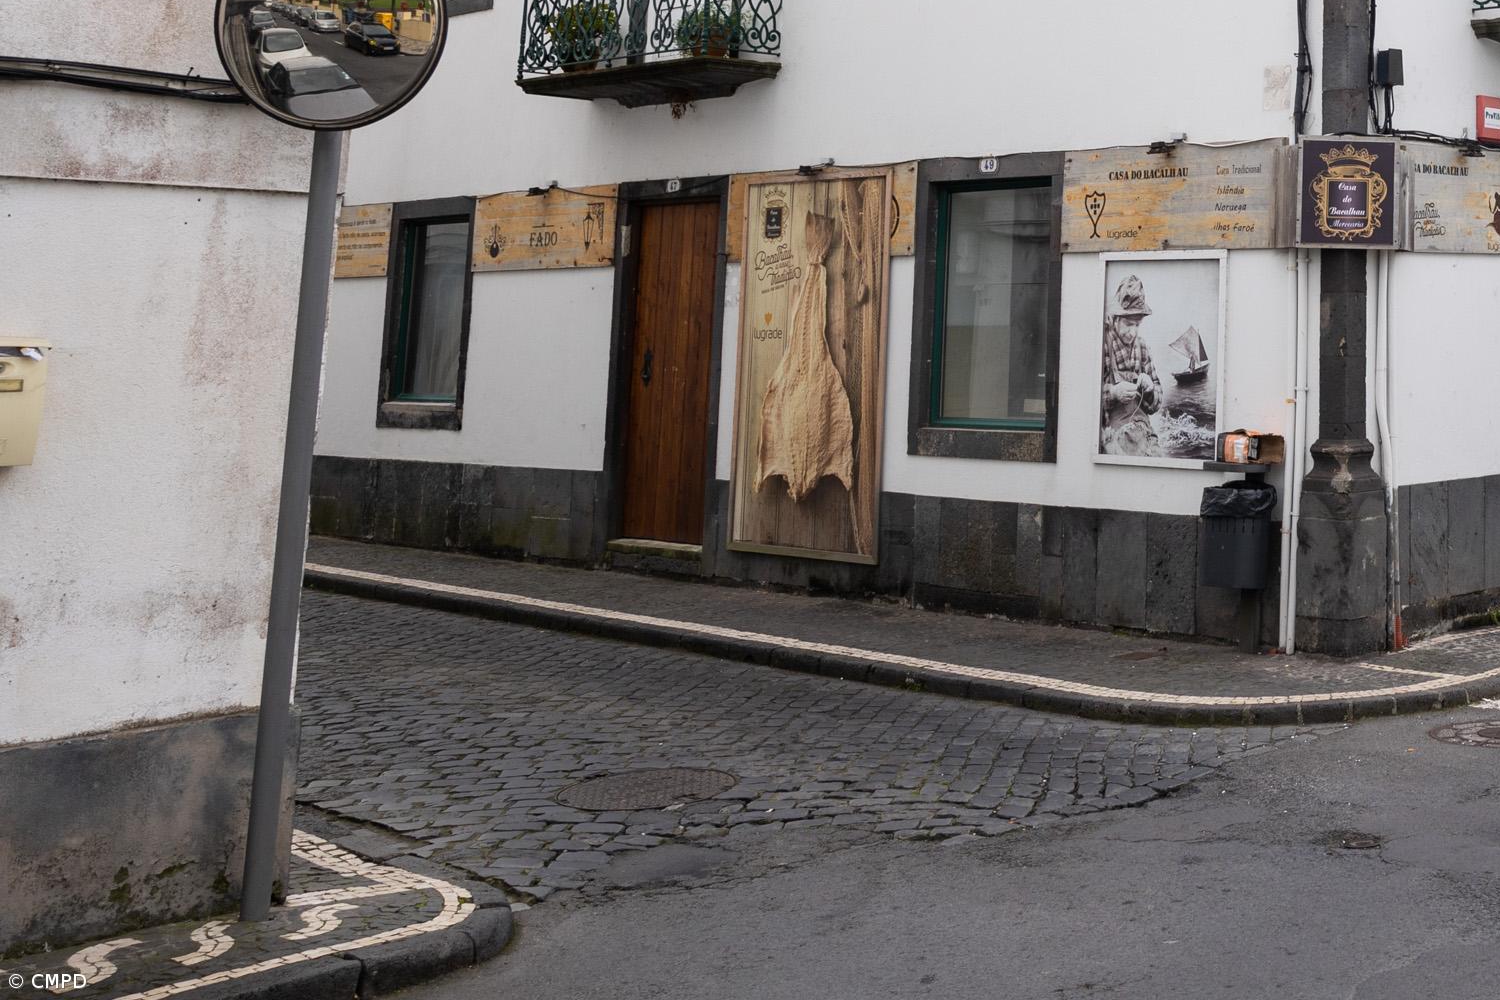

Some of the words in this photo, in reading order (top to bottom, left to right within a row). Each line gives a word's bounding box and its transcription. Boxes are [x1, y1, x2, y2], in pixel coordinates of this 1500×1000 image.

[984, 160, 994, 170] 49
[1232, 164, 1262, 175] Tradicional
[1422, 164, 1432, 174] DO
[1432, 165, 1469, 176] BACALHAU
[1109, 170, 1129, 181] CASA
[1131, 169, 1143, 180] DO
[1143, 167, 1189, 180] BACALHAU
[1216, 185, 1245, 195] Islândia
[1338, 182, 1357, 191] Casa
[1342, 195, 1352, 203] do
[1215, 202, 1247, 213] Noruega
[1329, 207, 1366, 216] Bacalhau
[529, 231, 558, 247] FADO
[1106, 229, 1138, 240] lugrade
[753, 327, 783, 341] lugrade
